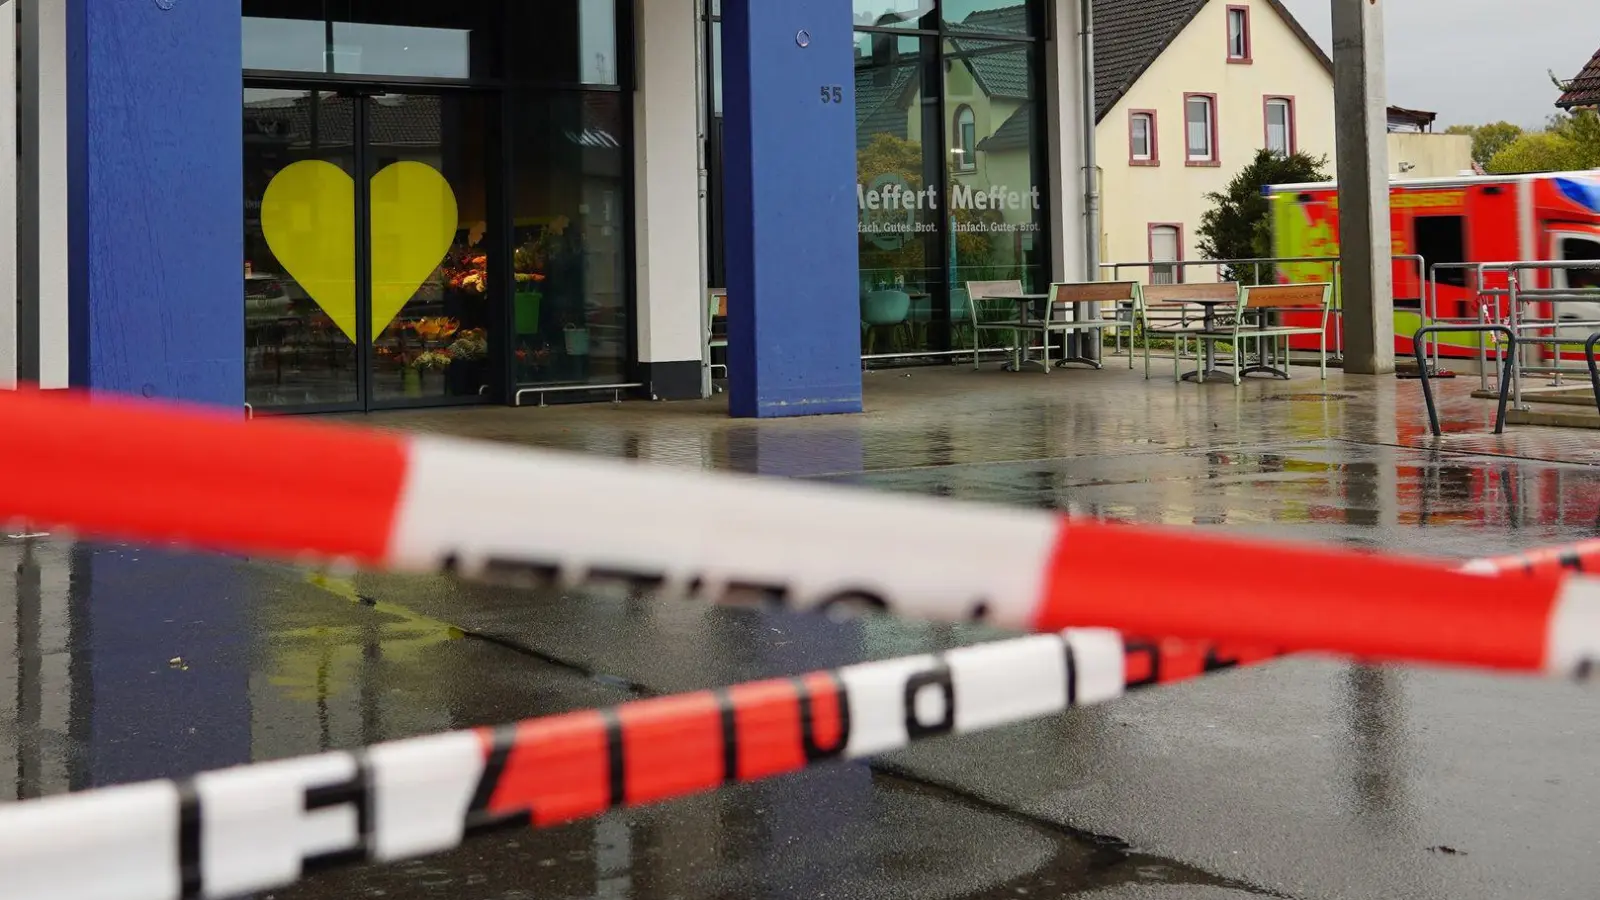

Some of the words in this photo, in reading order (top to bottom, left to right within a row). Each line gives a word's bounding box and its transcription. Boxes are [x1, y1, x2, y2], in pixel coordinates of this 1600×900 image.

[820, 86, 842, 104] 55
[951, 184, 1040, 210] Meffert
[857, 221, 882, 233] fach.
[883, 221, 913, 233] Gutes.
[915, 221, 938, 233] Brot.
[952, 221, 989, 233] Einfach.
[990, 221, 1019, 233] Gutes.
[1020, 221, 1040, 233] Brot.
